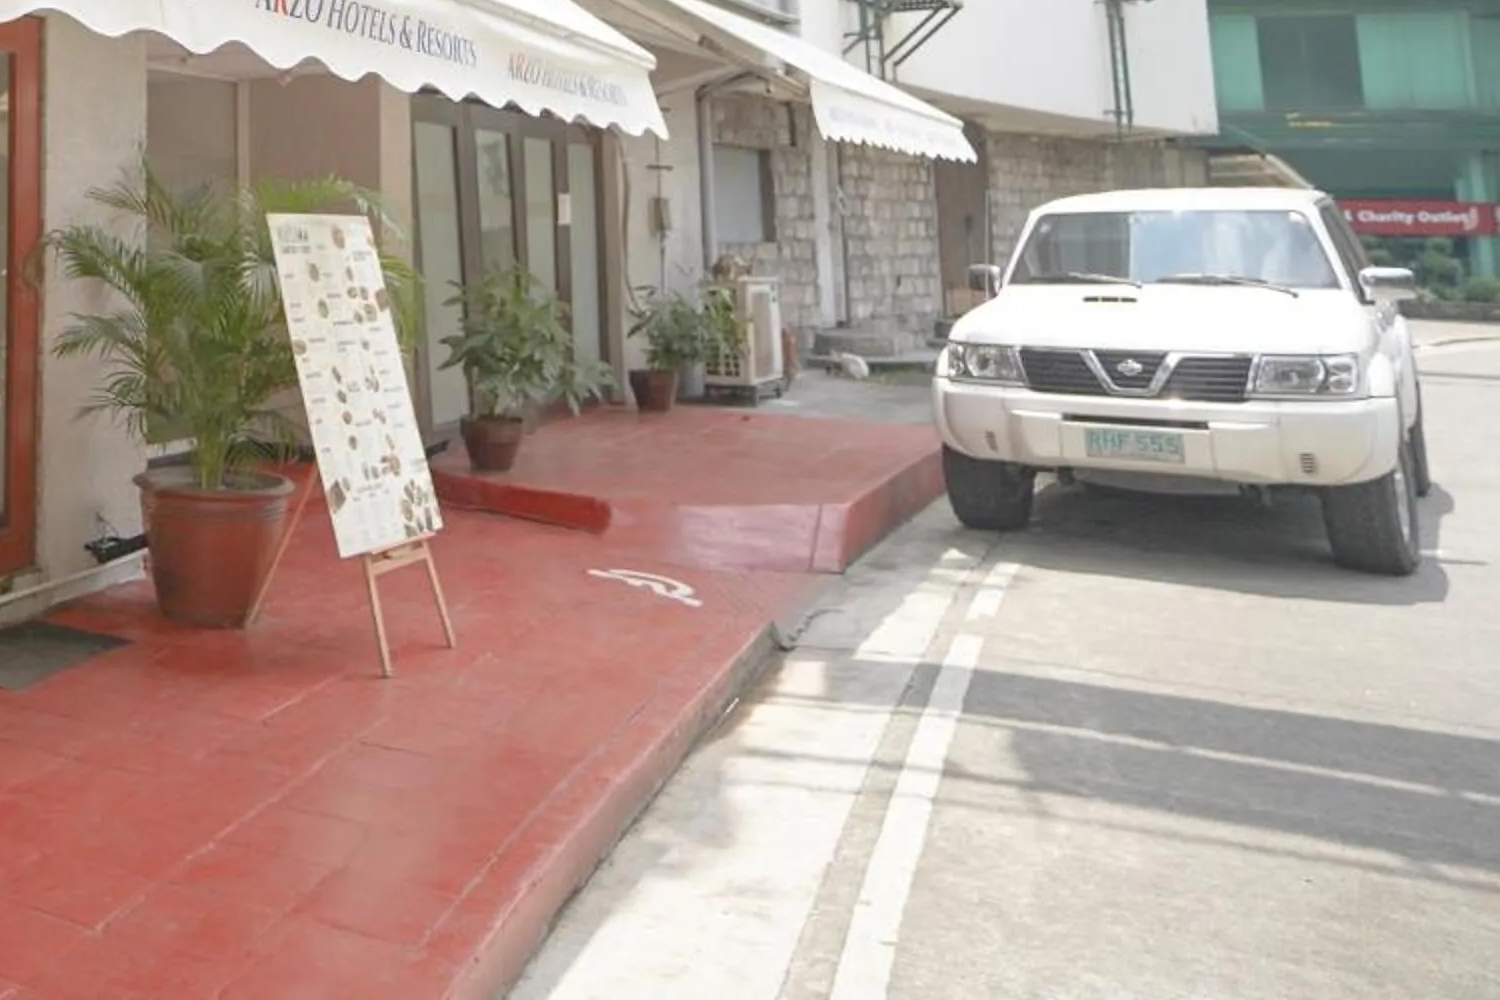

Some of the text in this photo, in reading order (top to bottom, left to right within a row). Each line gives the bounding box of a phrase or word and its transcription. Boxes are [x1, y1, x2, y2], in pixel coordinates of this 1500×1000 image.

[399, 15, 414, 50] &
[417, 20, 478, 68] RESORTS
[1357, 209, 1414, 226] Charity
